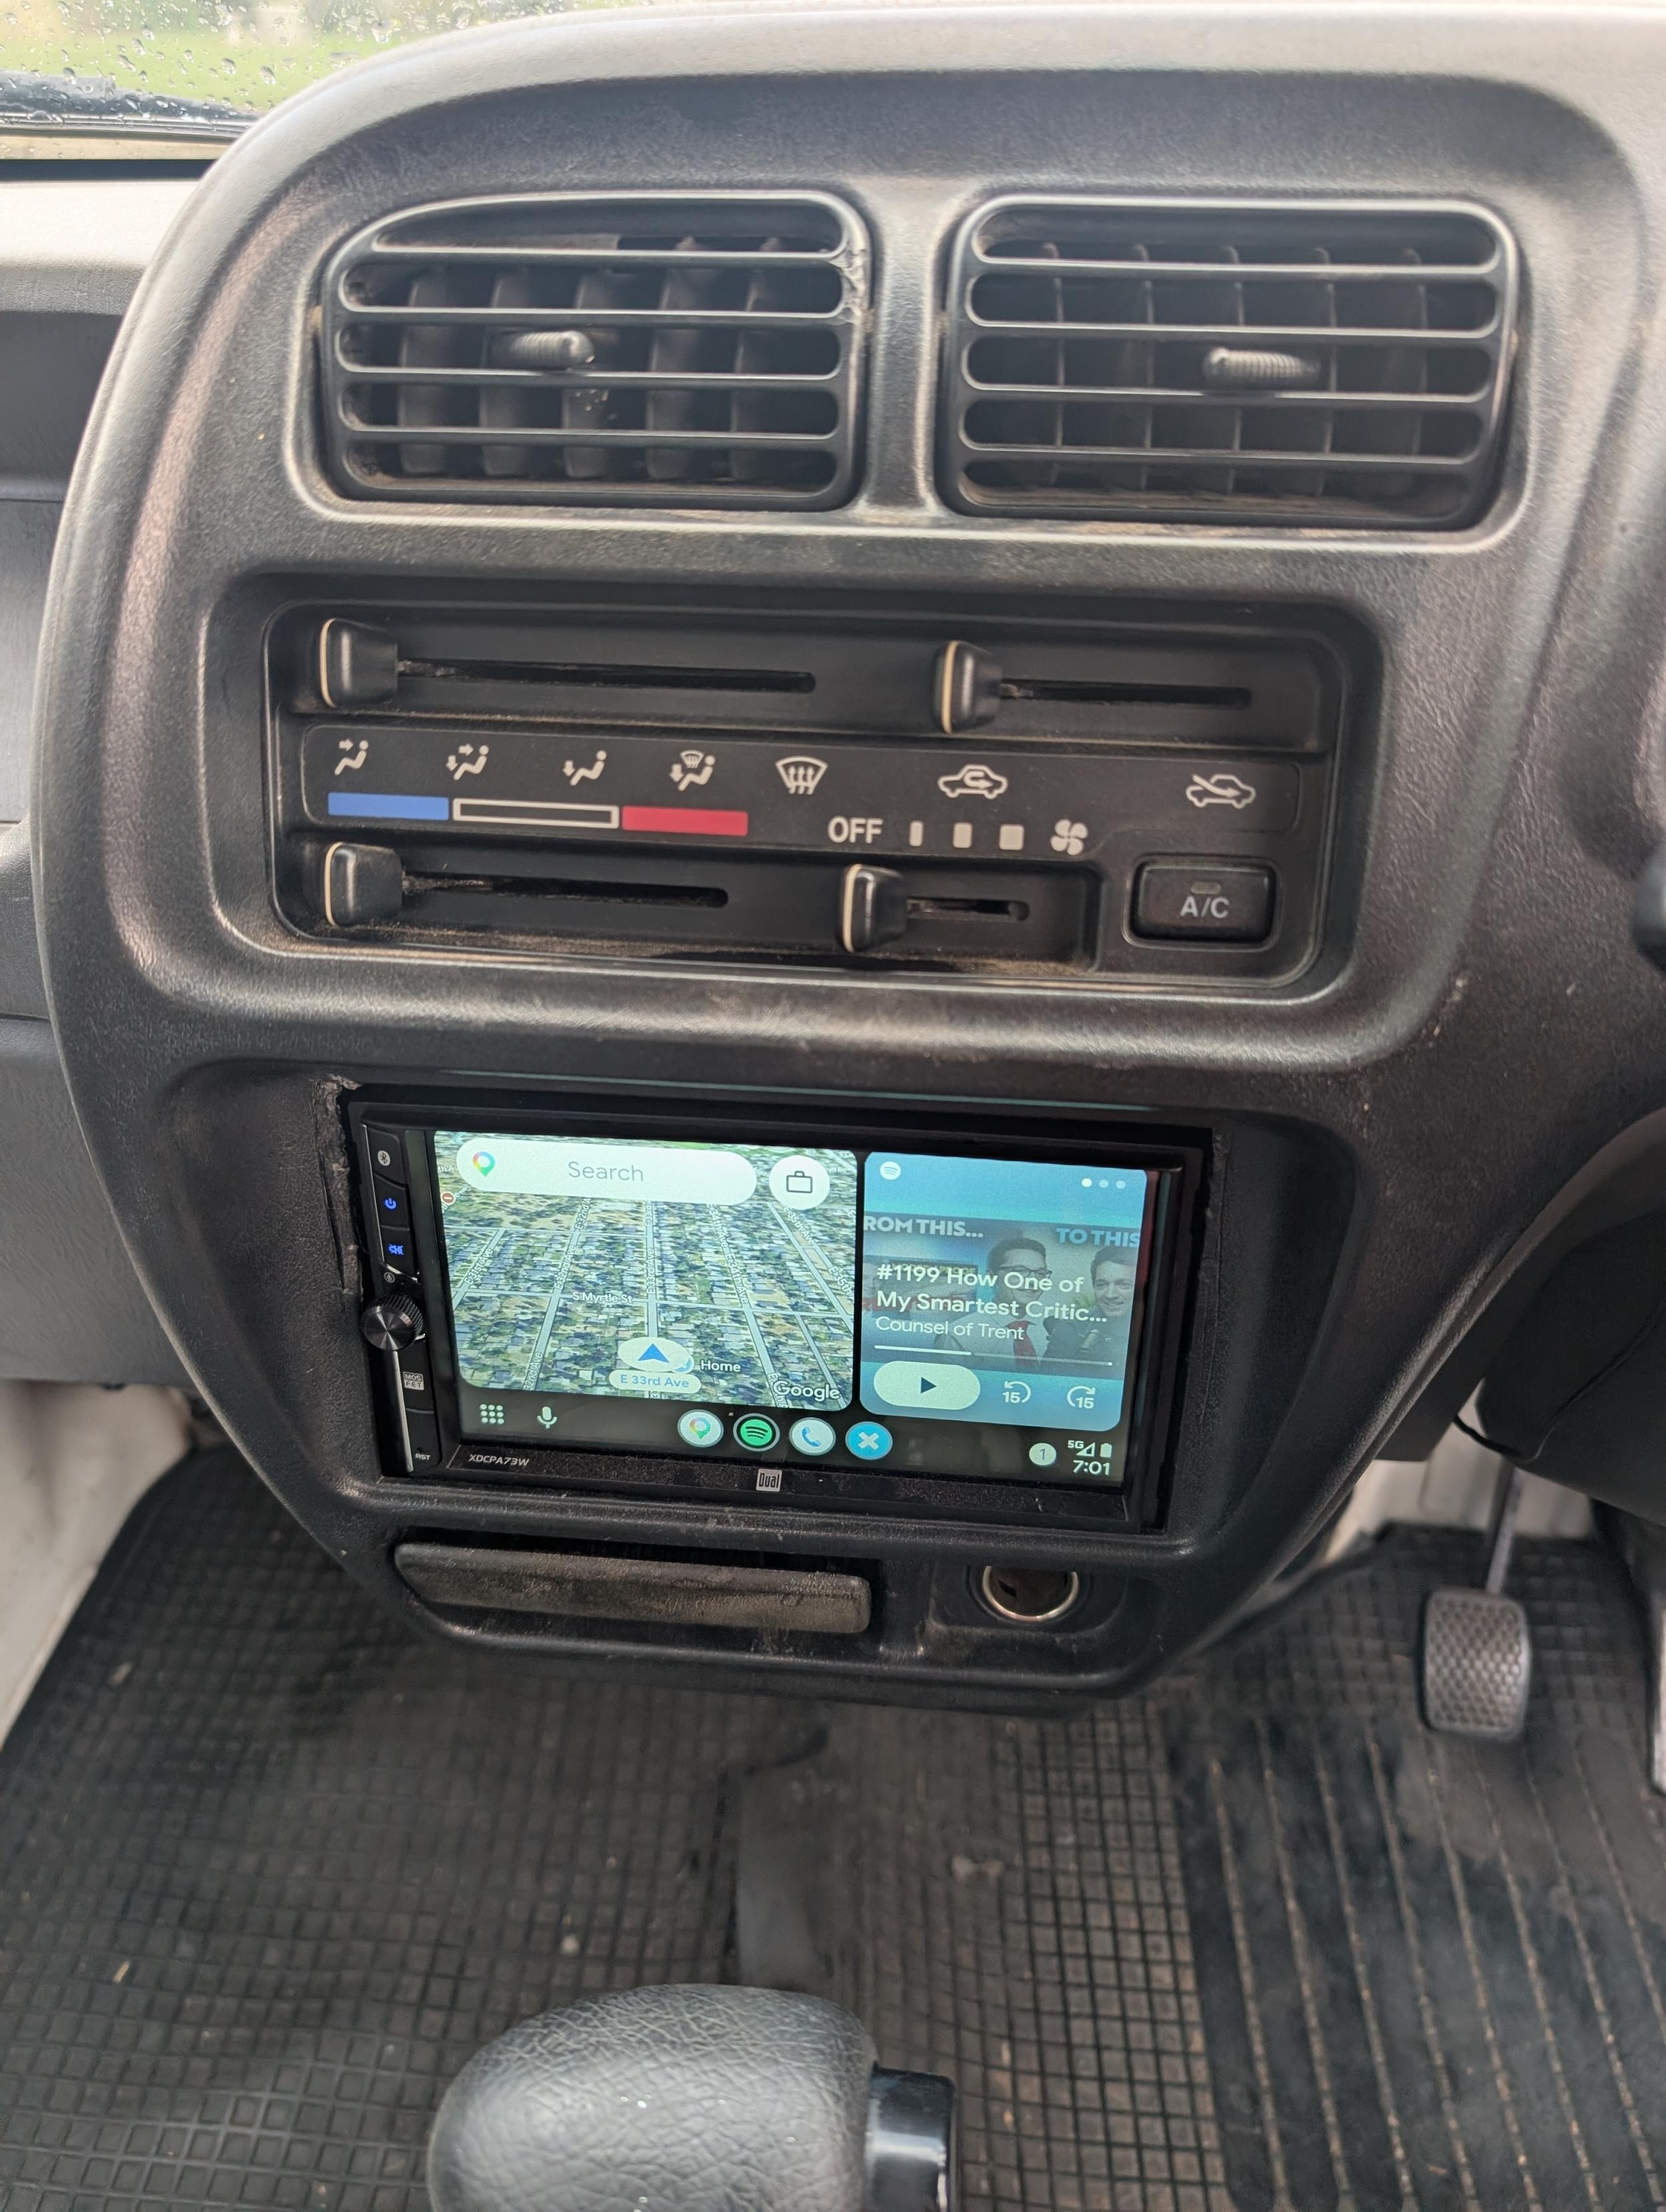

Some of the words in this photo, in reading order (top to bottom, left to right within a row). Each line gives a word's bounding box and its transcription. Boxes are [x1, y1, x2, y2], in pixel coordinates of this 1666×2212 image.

[828, 816, 884, 843] OFF
[1180, 895, 1230, 919] A/C
[568, 1161, 644, 1181] Search
[576, 1203, 589, 1223] 32nd
[916, 1219, 984, 1238] THIS...
[1056, 1228, 1088, 1244] TO
[717, 1231, 728, 1247] Ave
[801, 1231, 815, 1245] Ave
[468, 1263, 484, 1279] 31st
[478, 1248, 493, 1265] Ave
[556, 1262, 570, 1283] 32nd
[564, 1245, 576, 1261] Ave
[645, 1248, 654, 1265] Ave
[646, 1268, 655, 1287] 33rd
[728, 1262, 742, 1285] 34th
[736, 1286, 748, 1304] Ave
[828, 1266, 839, 1275] E
[834, 1274, 852, 1295] 35th
[876, 1263, 940, 1283] #1199
[947, 1268, 998, 1287] How
[1004, 1271, 1053, 1291] One
[1058, 1277, 1084, 1293] of
[572, 1292, 579, 1301] S
[582, 1292, 618, 1304] Myrtle
[620, 1294, 633, 1304] St
[877, 1290, 911, 1313] My
[917, 1293, 1020, 1317] Smartest
[1026, 1301, 1108, 1323] Critic...
[876, 1316, 948, 1335] Counsel
[954, 1323, 974, 1336] of
[978, 1323, 1025, 1341] Trent
[530, 1352, 542, 1368] Ave
[700, 1359, 742, 1373] Home
[405, 1373, 422, 1382] MOS
[620, 1375, 628, 1384] E
[631, 1375, 661, 1386] 33rd
[664, 1377, 690, 1388] Ave
[773, 1381, 840, 1402] Google
[1002, 1391, 1021, 1403] 15
[1076, 1396, 1094, 1408] 15
[1068, 1440, 1084, 1449] 5G
[468, 1454, 530, 1466] XDCPA73W
[1072, 1459, 1111, 1476] 7:01
[758, 1472, 781, 1489] Dual
